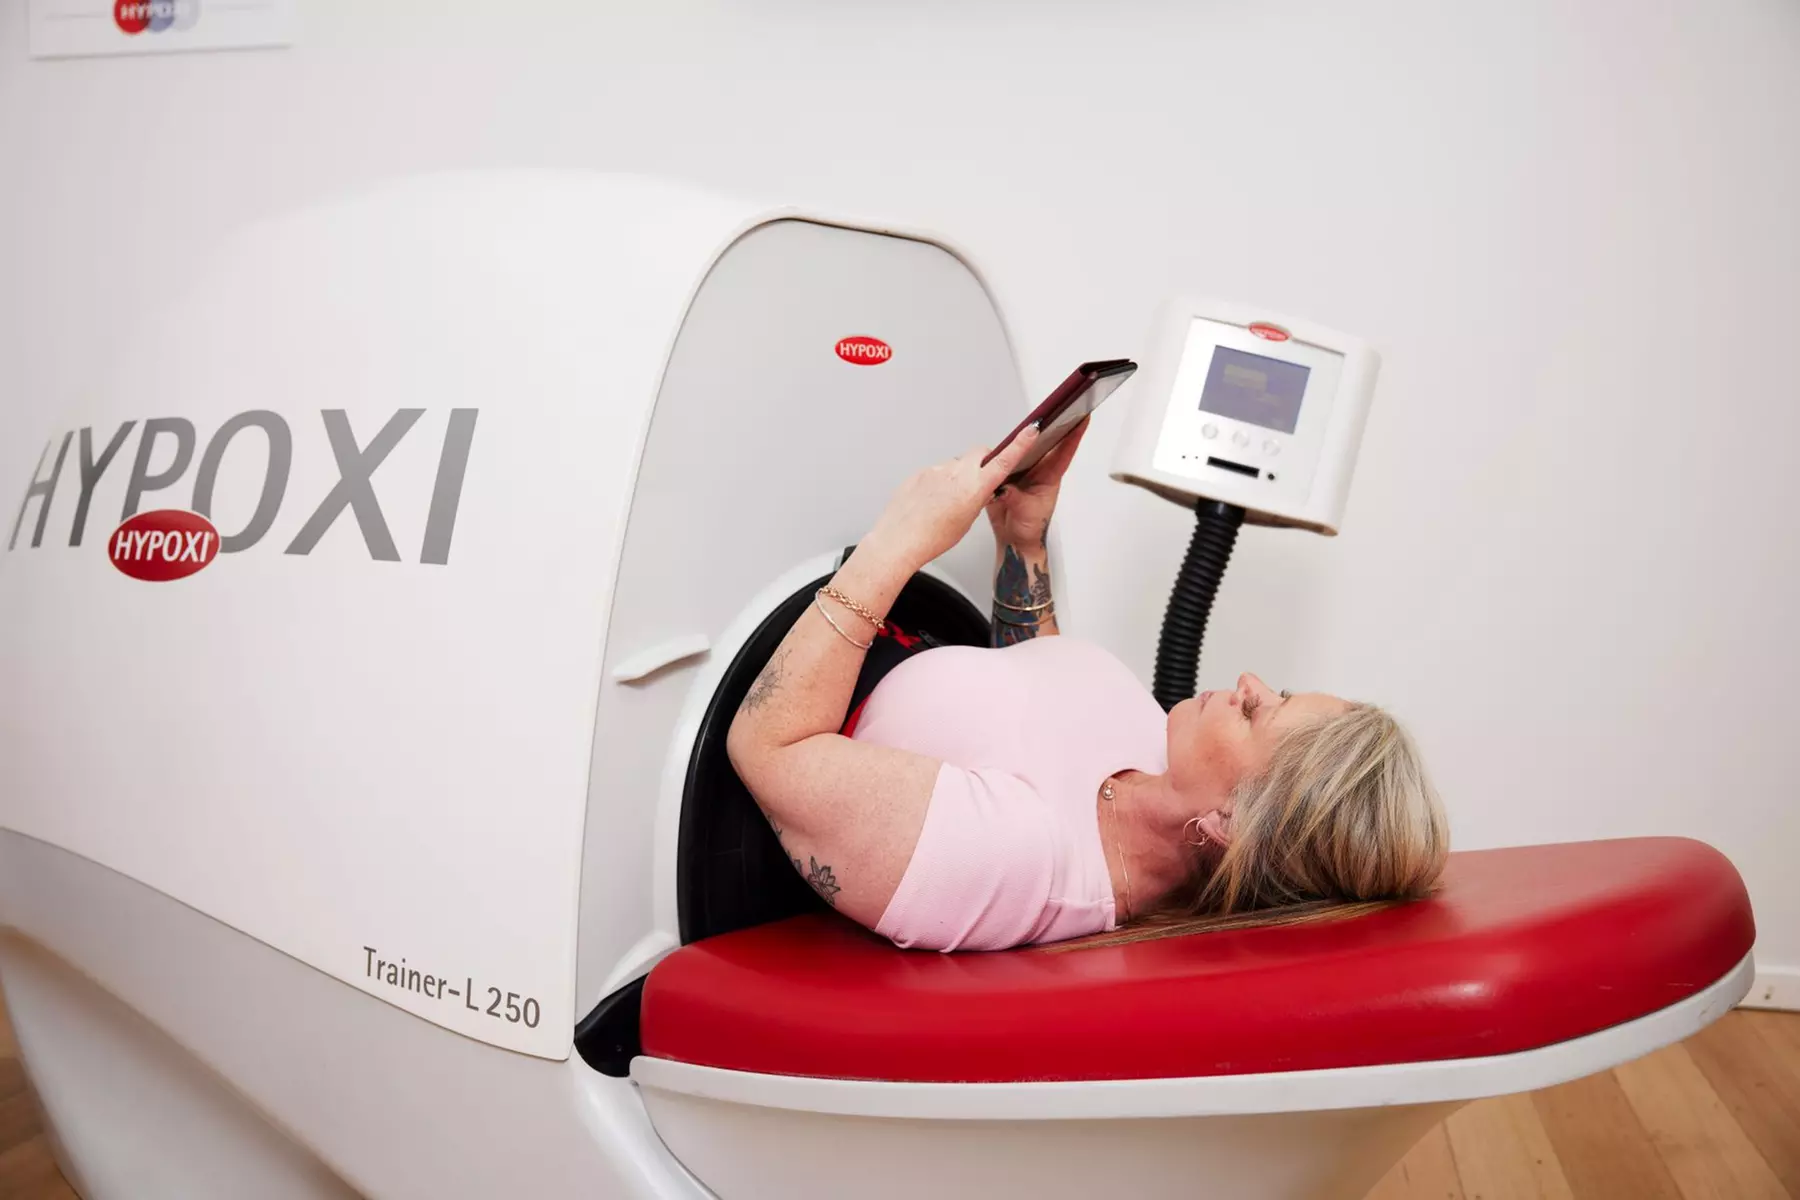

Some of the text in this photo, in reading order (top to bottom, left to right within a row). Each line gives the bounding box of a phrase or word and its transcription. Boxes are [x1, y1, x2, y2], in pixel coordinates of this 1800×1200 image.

[840, 342, 889, 358] HYPOXI
[8, 408, 479, 565] HYPOXI
[486, 986, 541, 1029] 250
